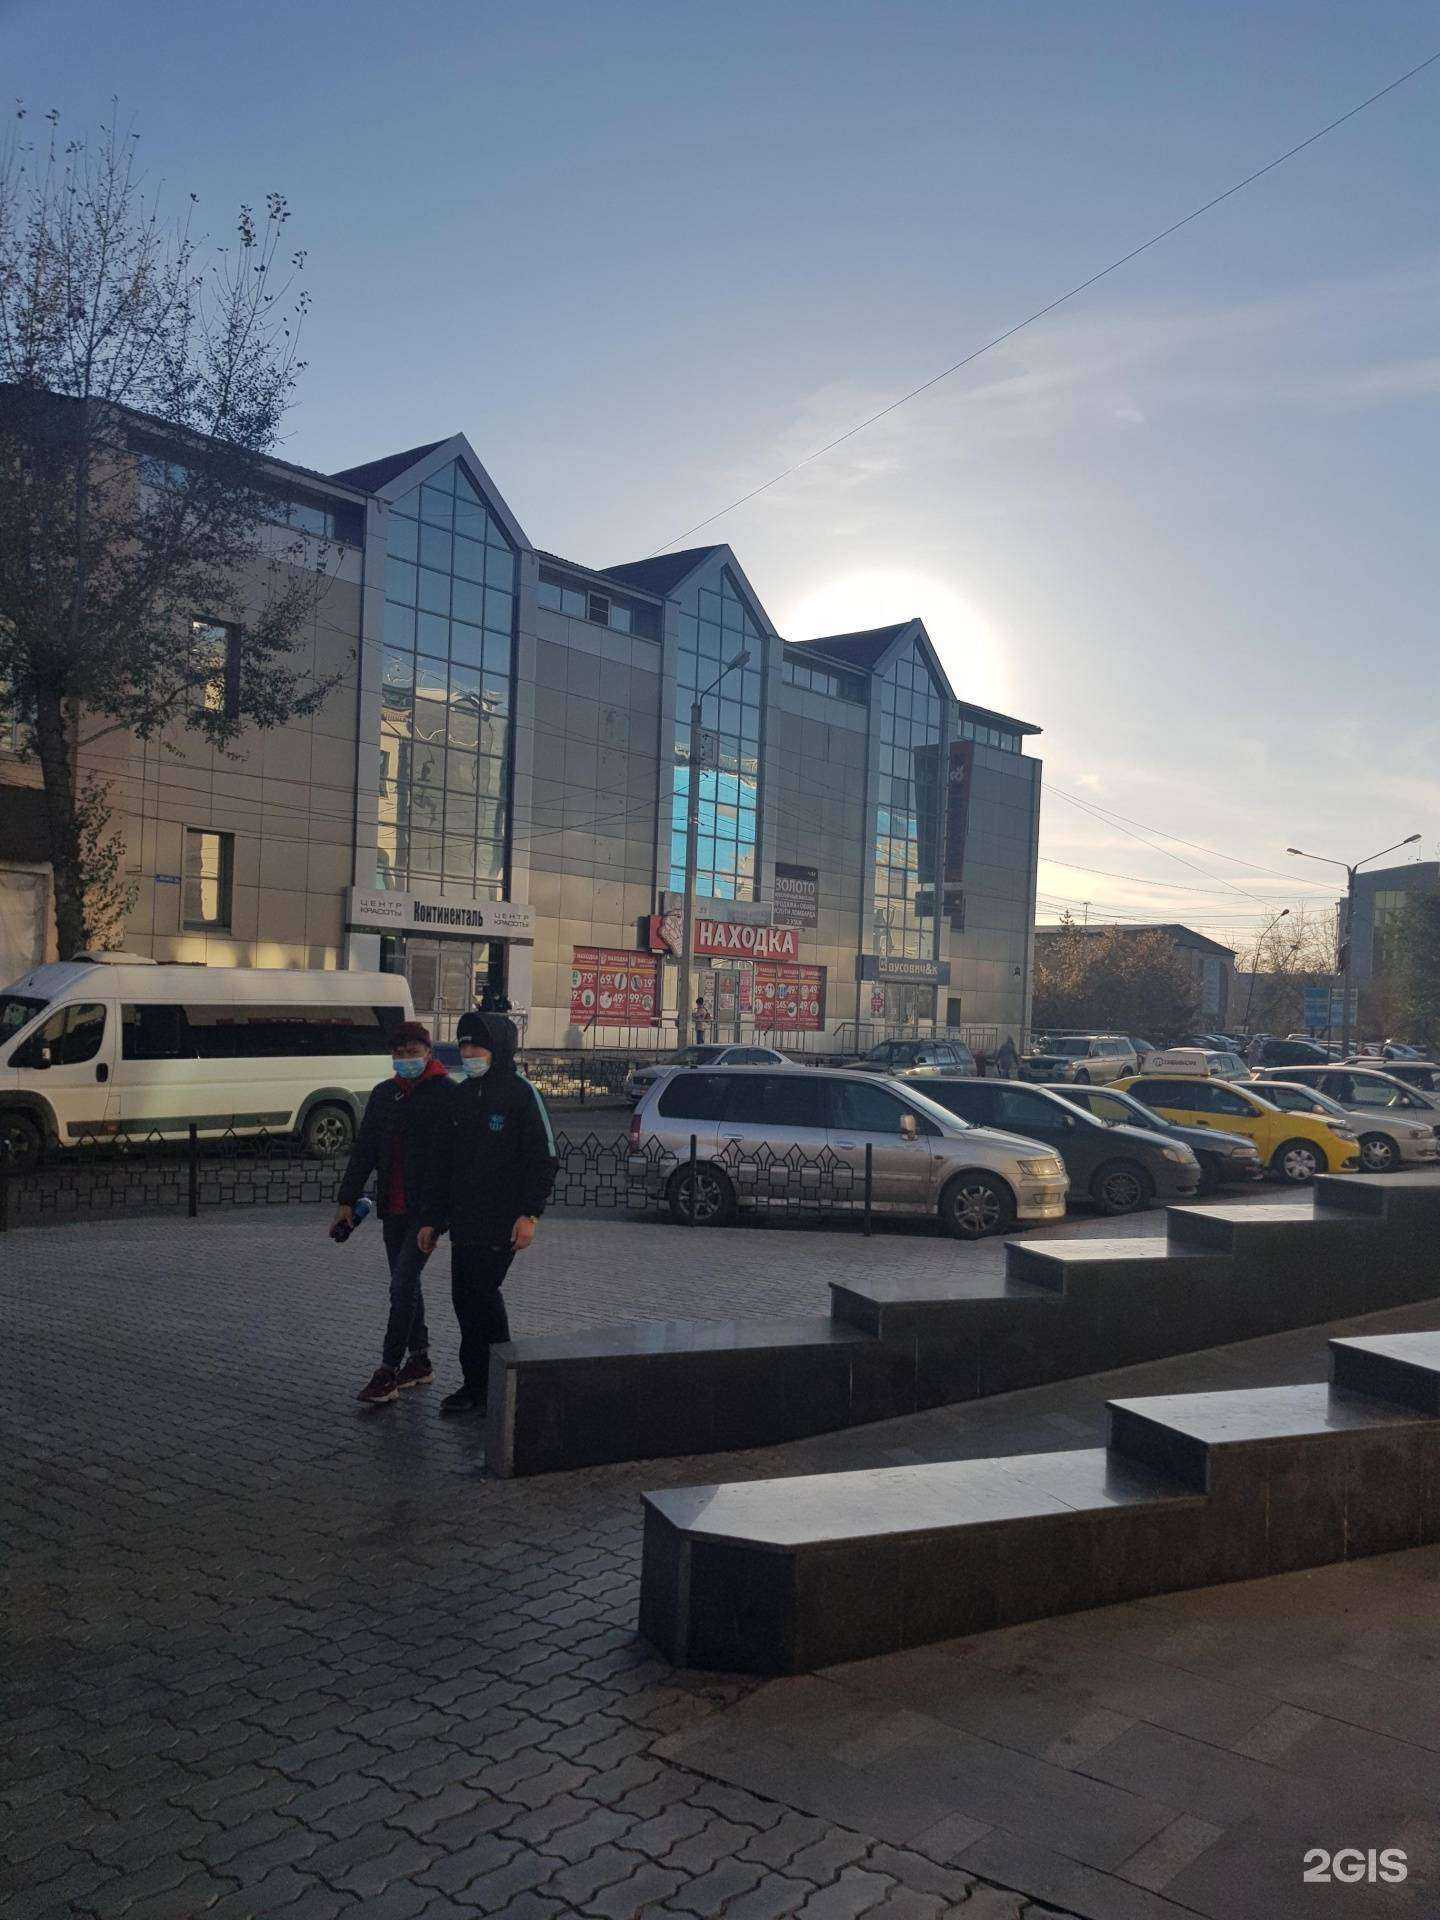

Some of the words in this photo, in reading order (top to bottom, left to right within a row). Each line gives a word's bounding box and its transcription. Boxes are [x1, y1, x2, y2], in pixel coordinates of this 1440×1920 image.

[775, 878, 816, 896] ЗОЛОТО
[360, 899, 402, 908] ЦЕНТР
[413, 901, 484, 927] Континенталь
[700, 921, 794, 957] НАХОДКА
